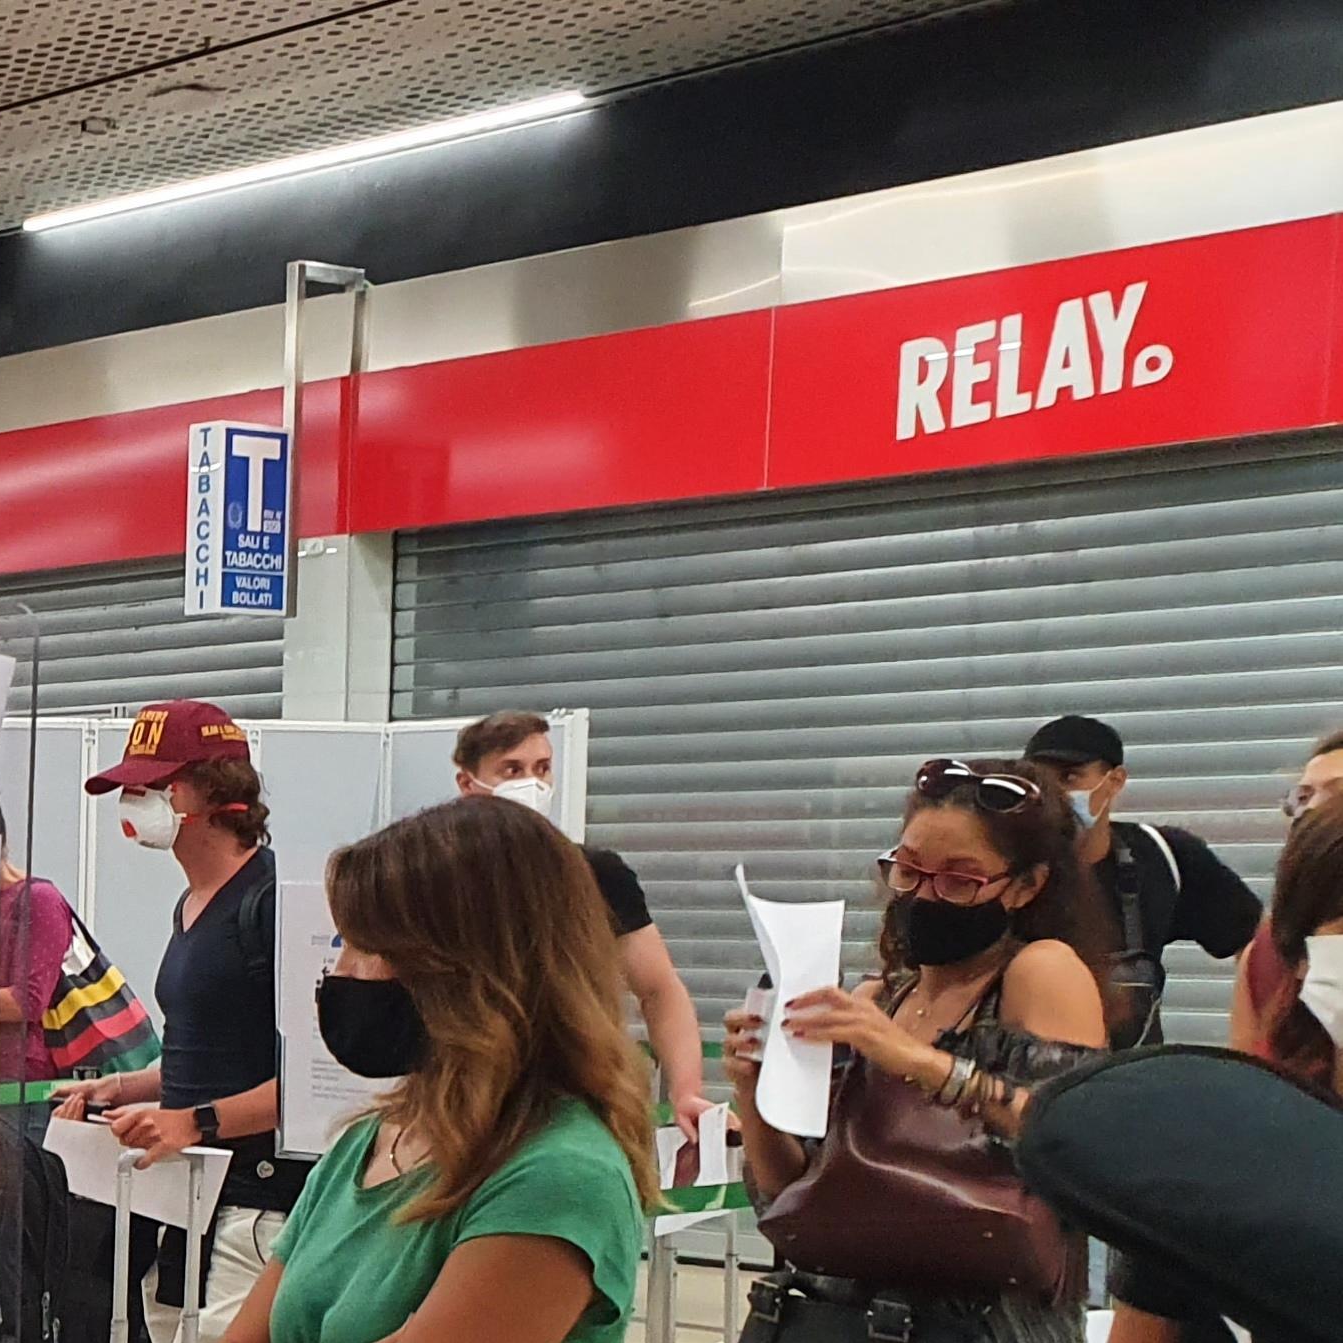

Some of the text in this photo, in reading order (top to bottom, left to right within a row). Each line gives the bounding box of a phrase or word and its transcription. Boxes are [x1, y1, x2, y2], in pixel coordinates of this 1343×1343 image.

[895, 280, 1149, 441] RELAY
[231, 434, 281, 532] T
[195, 427, 212, 609] TABACCHI
[238, 533, 270, 550] SALI E
[225, 550, 282, 570] TABACCHI
[235, 575, 271, 591] VALORI
[232, 591, 273, 606] BOLLATI
